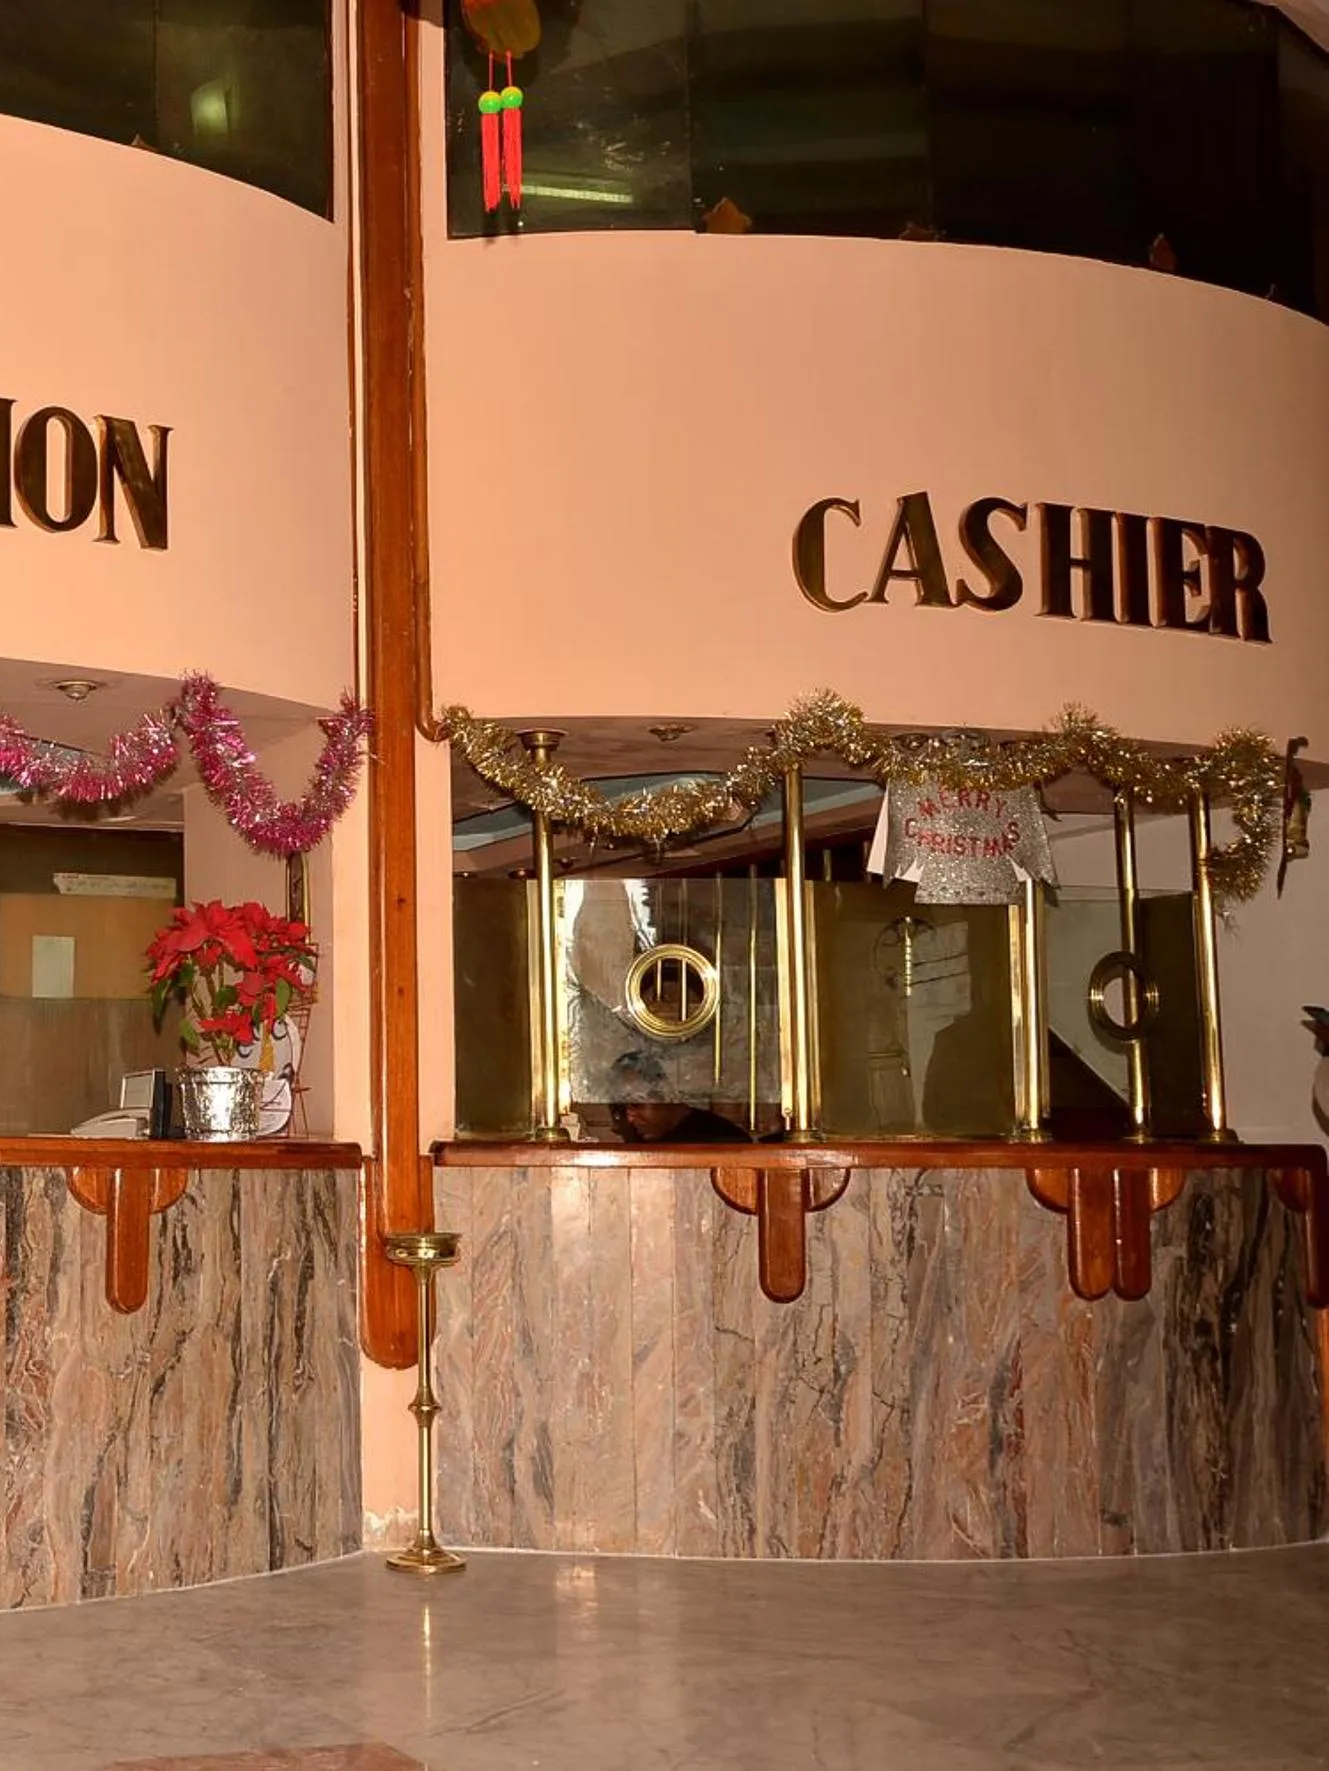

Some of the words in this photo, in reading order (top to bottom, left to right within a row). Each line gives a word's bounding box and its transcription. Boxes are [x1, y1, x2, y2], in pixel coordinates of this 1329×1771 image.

[791, 491, 1272, 643] CASHIER
[918, 786, 1008, 818] MERRY
[904, 817, 1021, 858] CHRISTMAS
